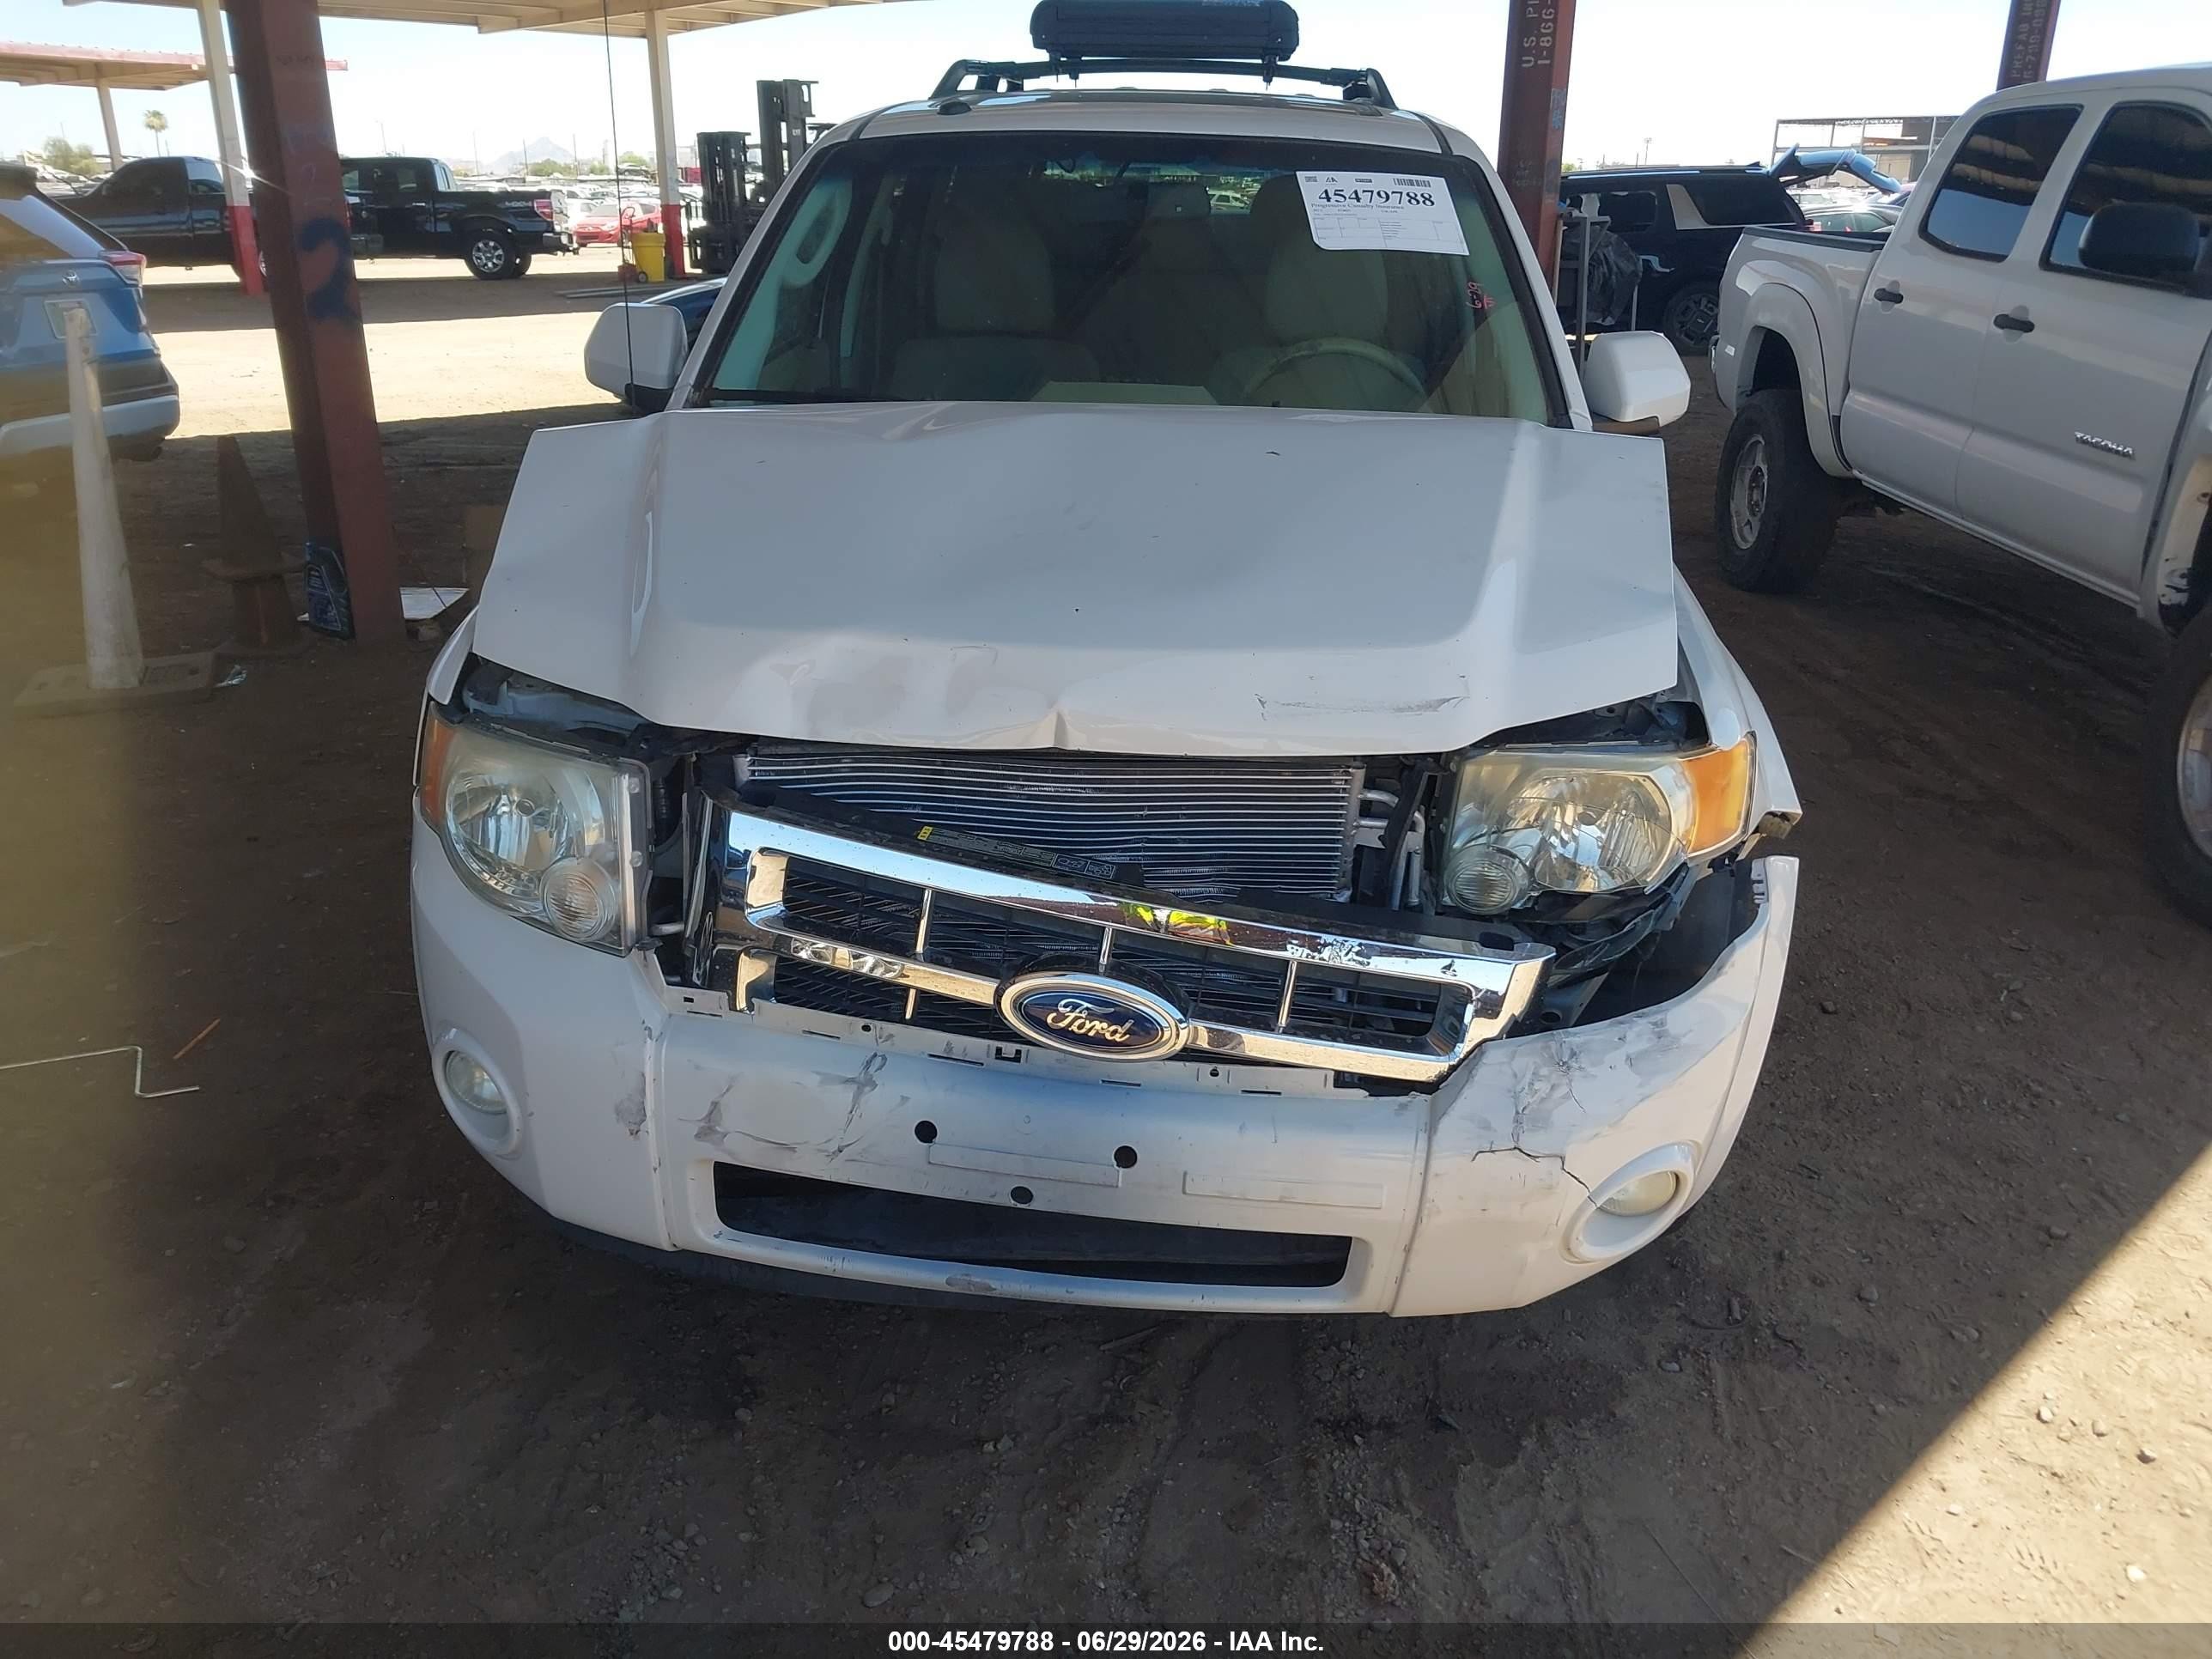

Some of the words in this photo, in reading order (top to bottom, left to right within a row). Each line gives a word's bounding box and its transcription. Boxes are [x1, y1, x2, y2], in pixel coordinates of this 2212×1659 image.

[1521, 29, 1538, 68] U.S.
[1318, 188, 1435, 207] 45479788
[299, 218, 362, 324] 2
[2074, 431, 2136, 459] TACOMA
[1046, 999, 1134, 1042] Ford
